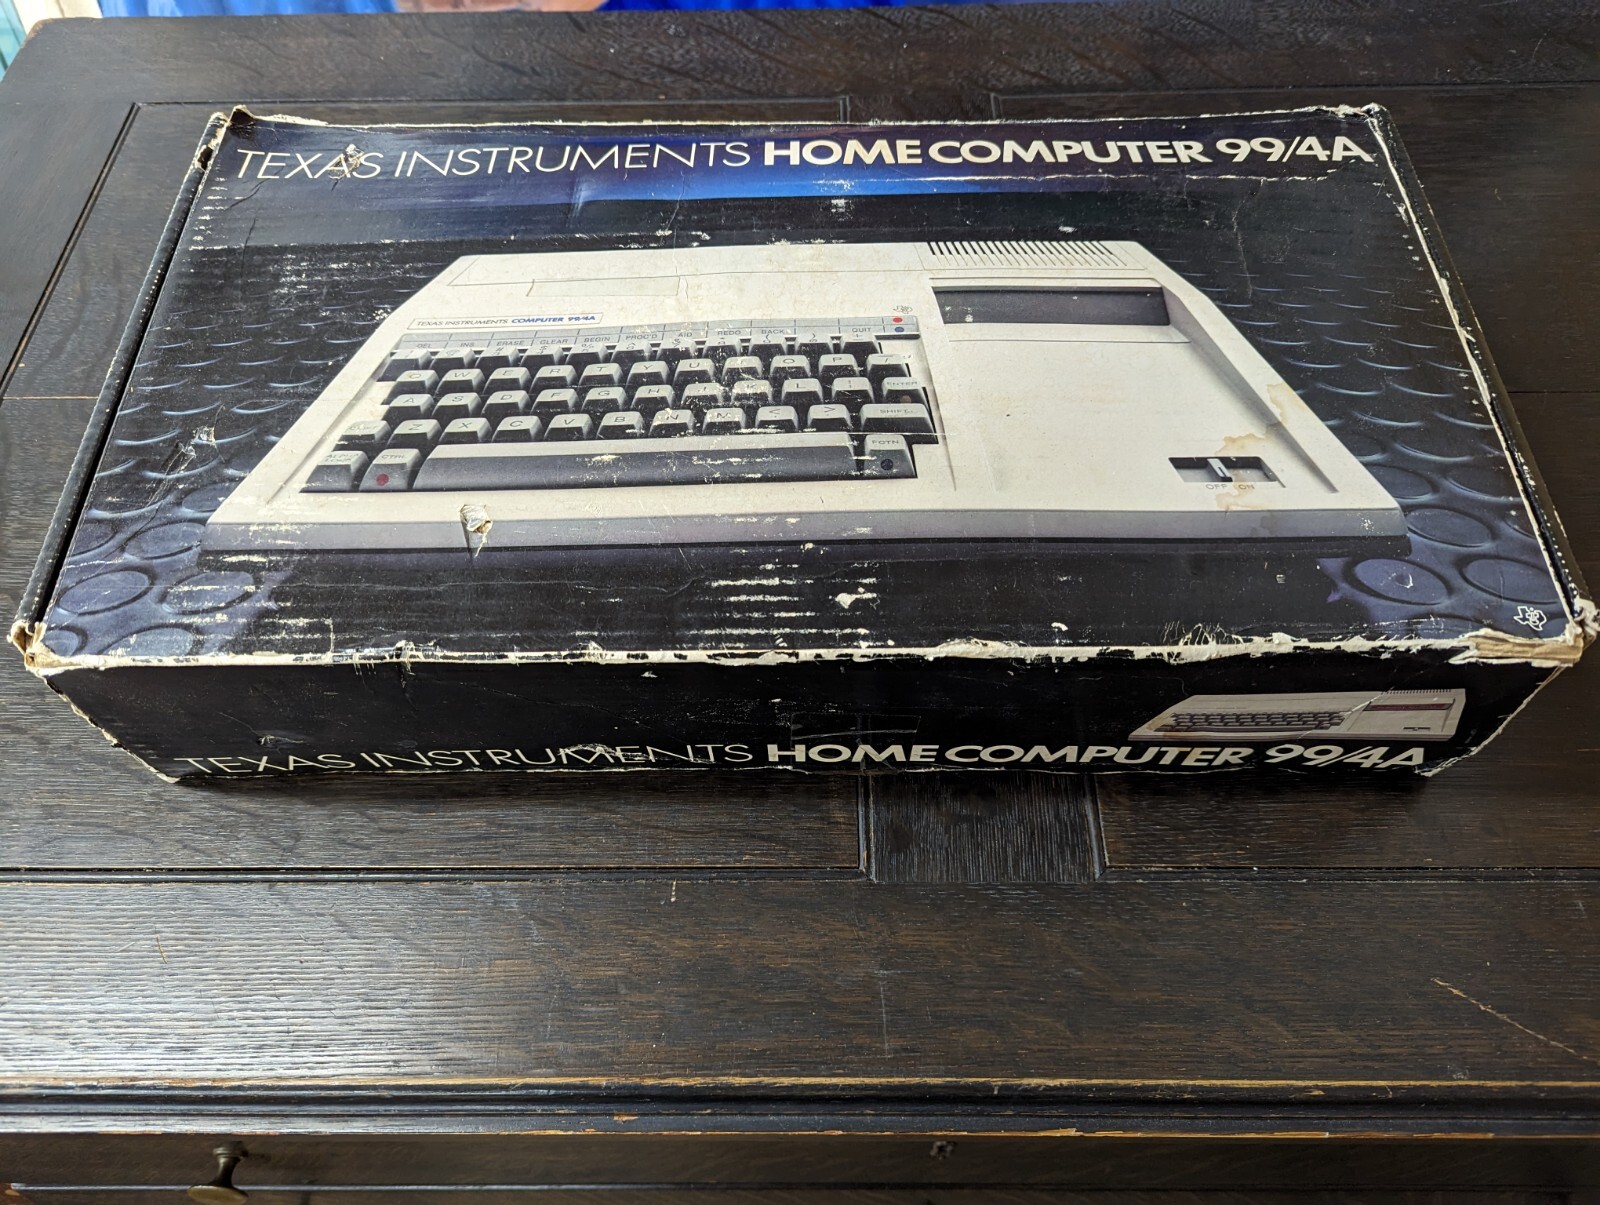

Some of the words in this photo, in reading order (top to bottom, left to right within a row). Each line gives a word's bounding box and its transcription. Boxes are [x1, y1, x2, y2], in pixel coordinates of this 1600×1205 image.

[237, 149, 384, 180] TEXAS
[394, 140, 750, 178] INSTRUMENTS
[763, 138, 923, 166] HOME
[927, 137, 1213, 165] COMPUTER
[1214, 135, 1376, 164] 99/4A
[511, 316, 564, 324] COMPUTER
[174, 752, 356, 775] TEXAS
[361, 743, 752, 770] INSTRUMENTS
[767, 741, 938, 765] HOME
[944, 743, 1253, 767] COMPUTER
[1263, 743, 1426, 769] 99/4A
